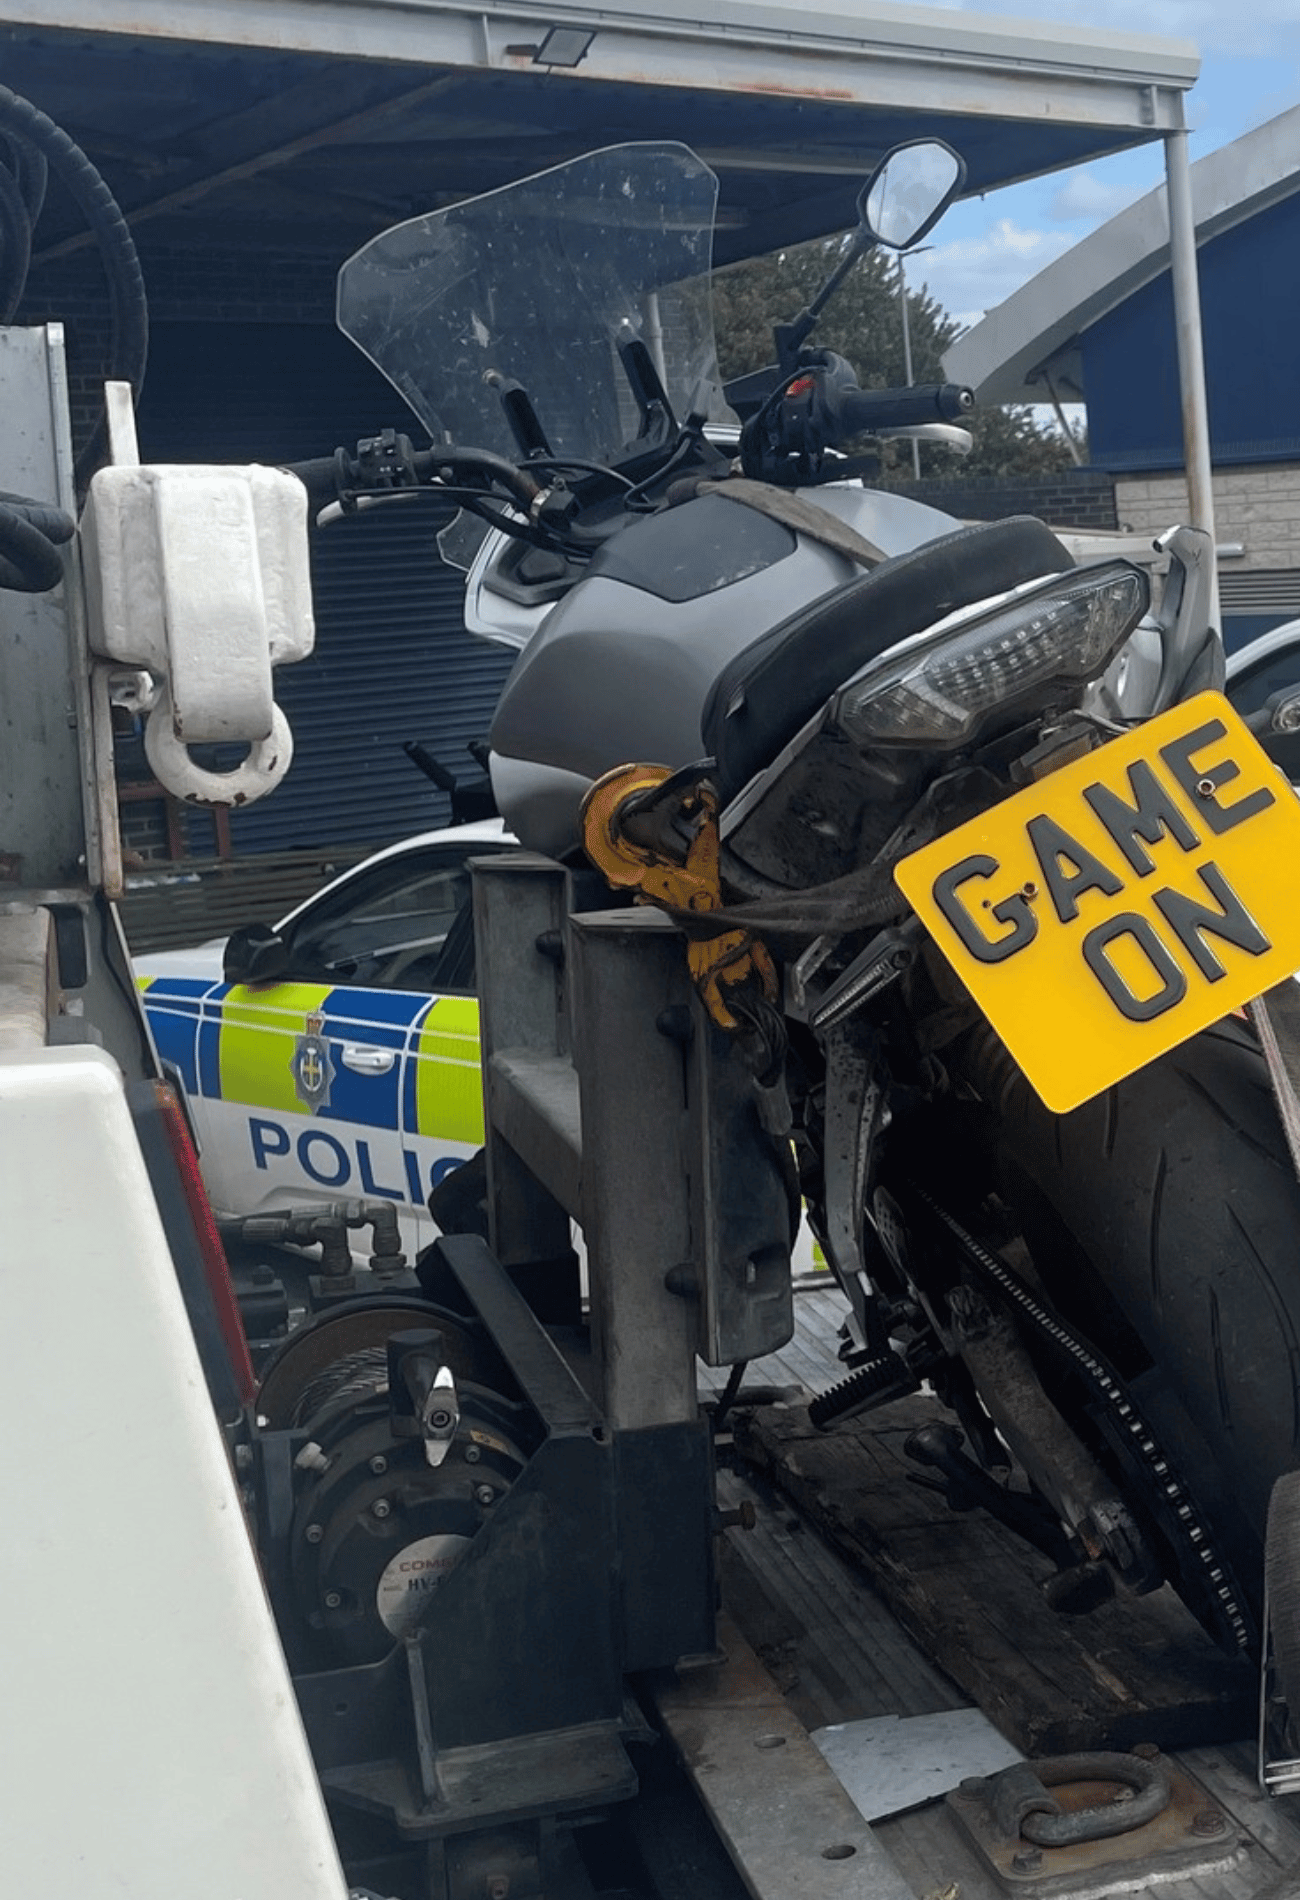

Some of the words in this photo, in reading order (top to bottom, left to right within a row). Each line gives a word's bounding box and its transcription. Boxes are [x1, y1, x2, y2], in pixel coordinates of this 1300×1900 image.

[932, 718, 1276, 963] GAME
[1082, 860, 1272, 1022] ON
[248, 1117, 470, 1207] POLI
